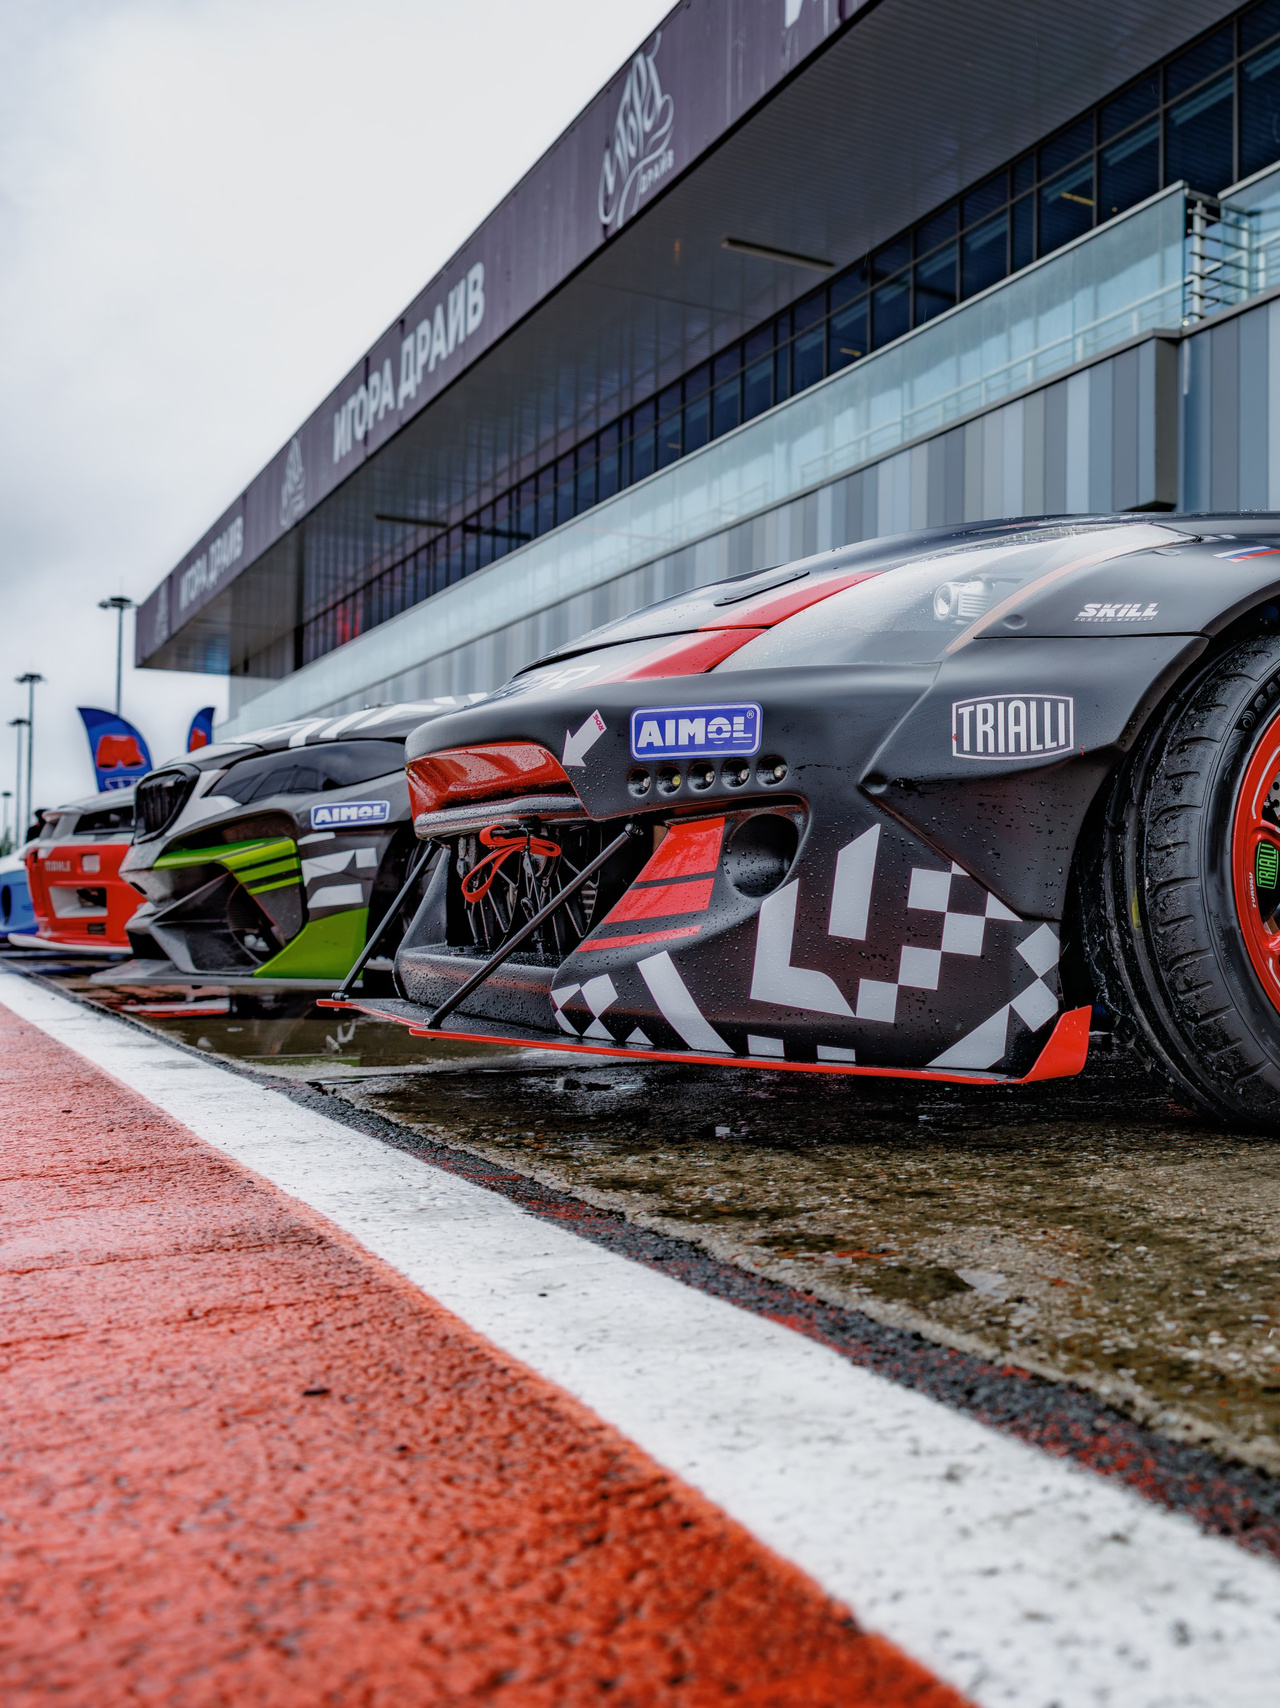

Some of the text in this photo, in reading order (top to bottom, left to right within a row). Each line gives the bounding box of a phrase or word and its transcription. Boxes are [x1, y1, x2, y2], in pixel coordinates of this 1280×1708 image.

[333, 357, 394, 464] ИГОРА
[1078, 603, 1159, 617] SKILL
[637, 716, 753, 748] AIMOL
[958, 700, 1065, 753] TRIALLI
[315, 805, 385, 823] AIMOL
